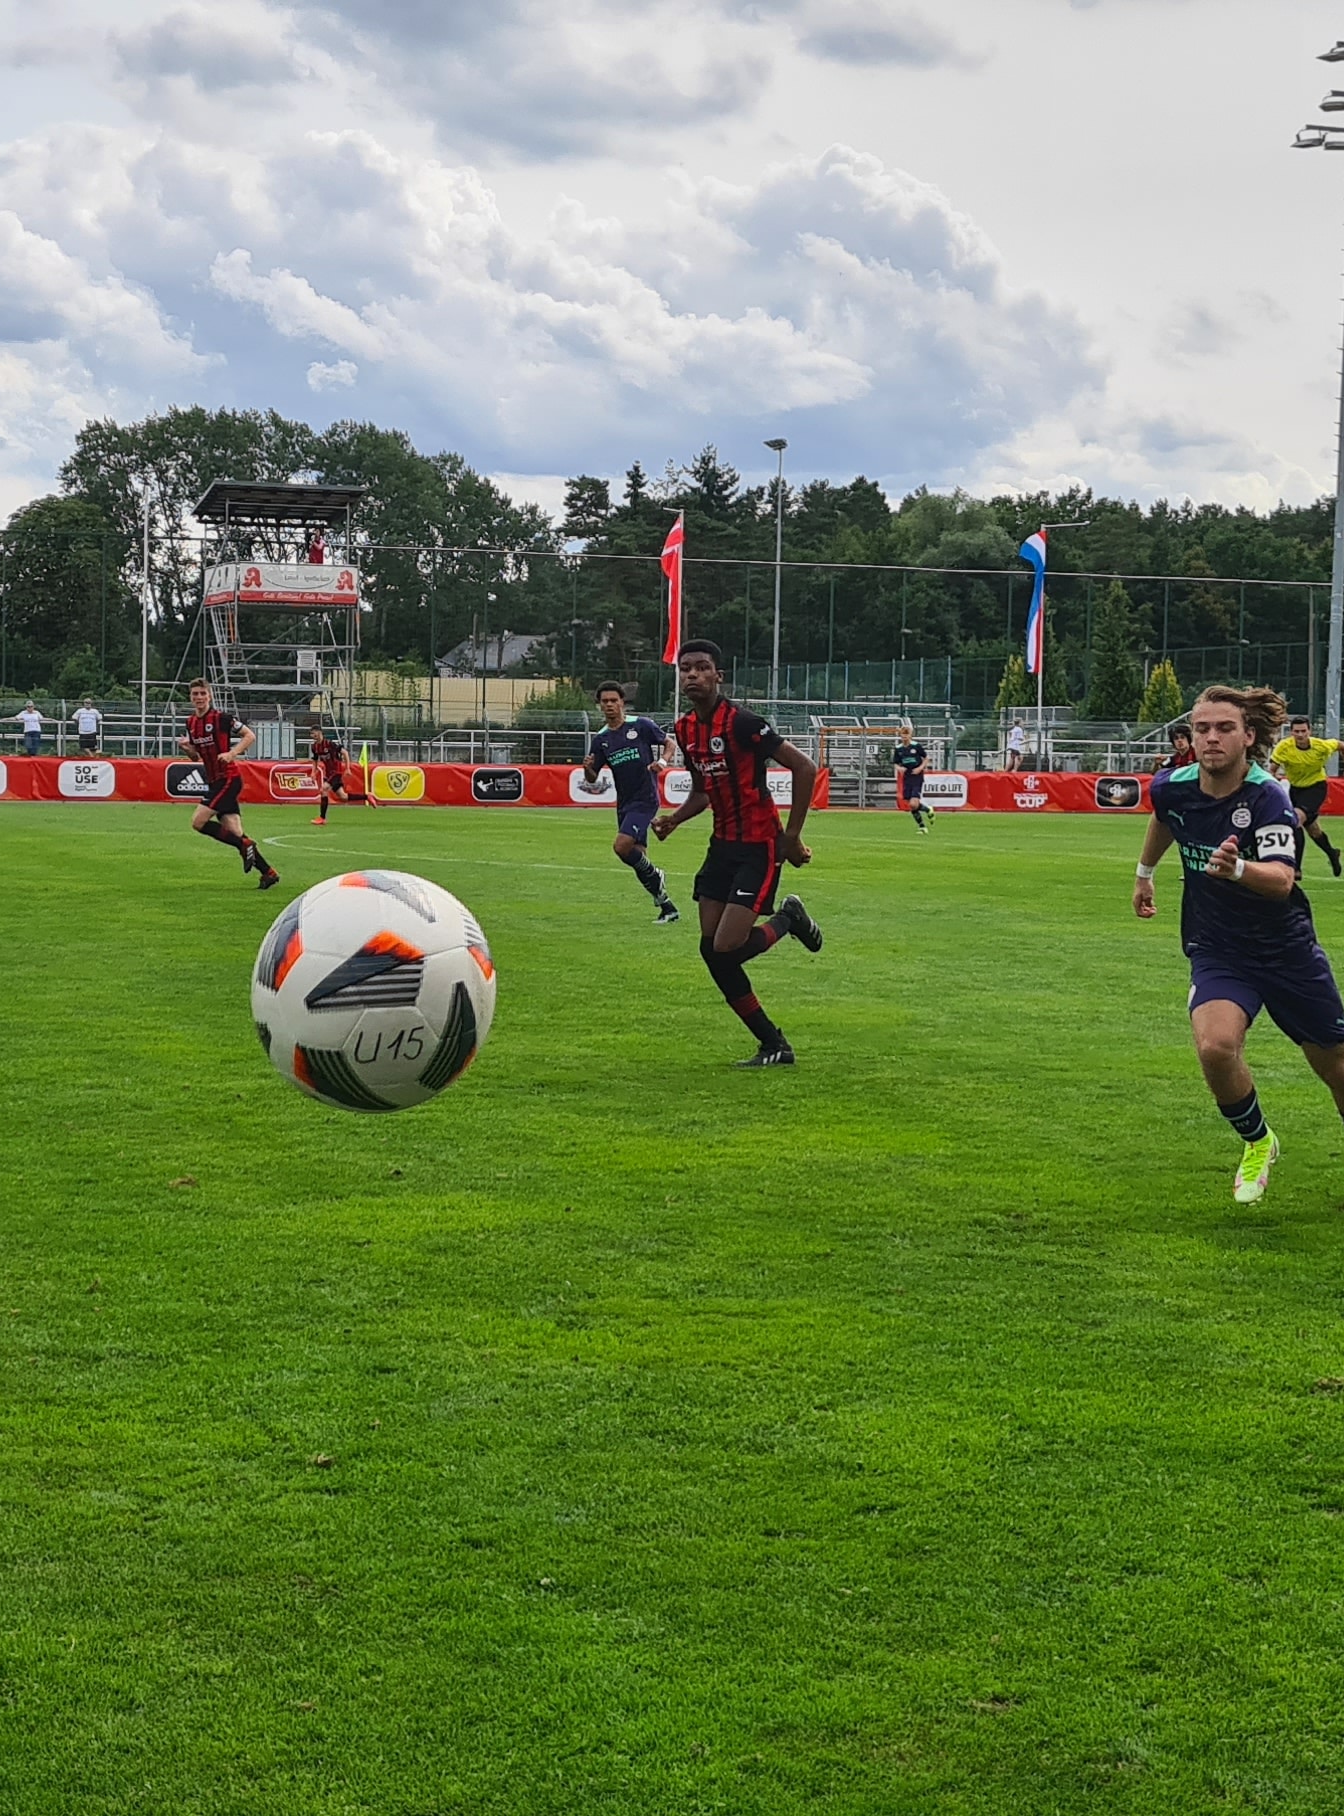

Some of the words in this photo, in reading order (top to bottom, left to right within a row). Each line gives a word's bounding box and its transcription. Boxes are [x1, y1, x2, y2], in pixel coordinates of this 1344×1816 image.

[74, 765, 92, 775] SO
[74, 775, 99, 784] USE
[948, 784, 963, 793] LIFE
[1016, 796, 1046, 808] CUP
